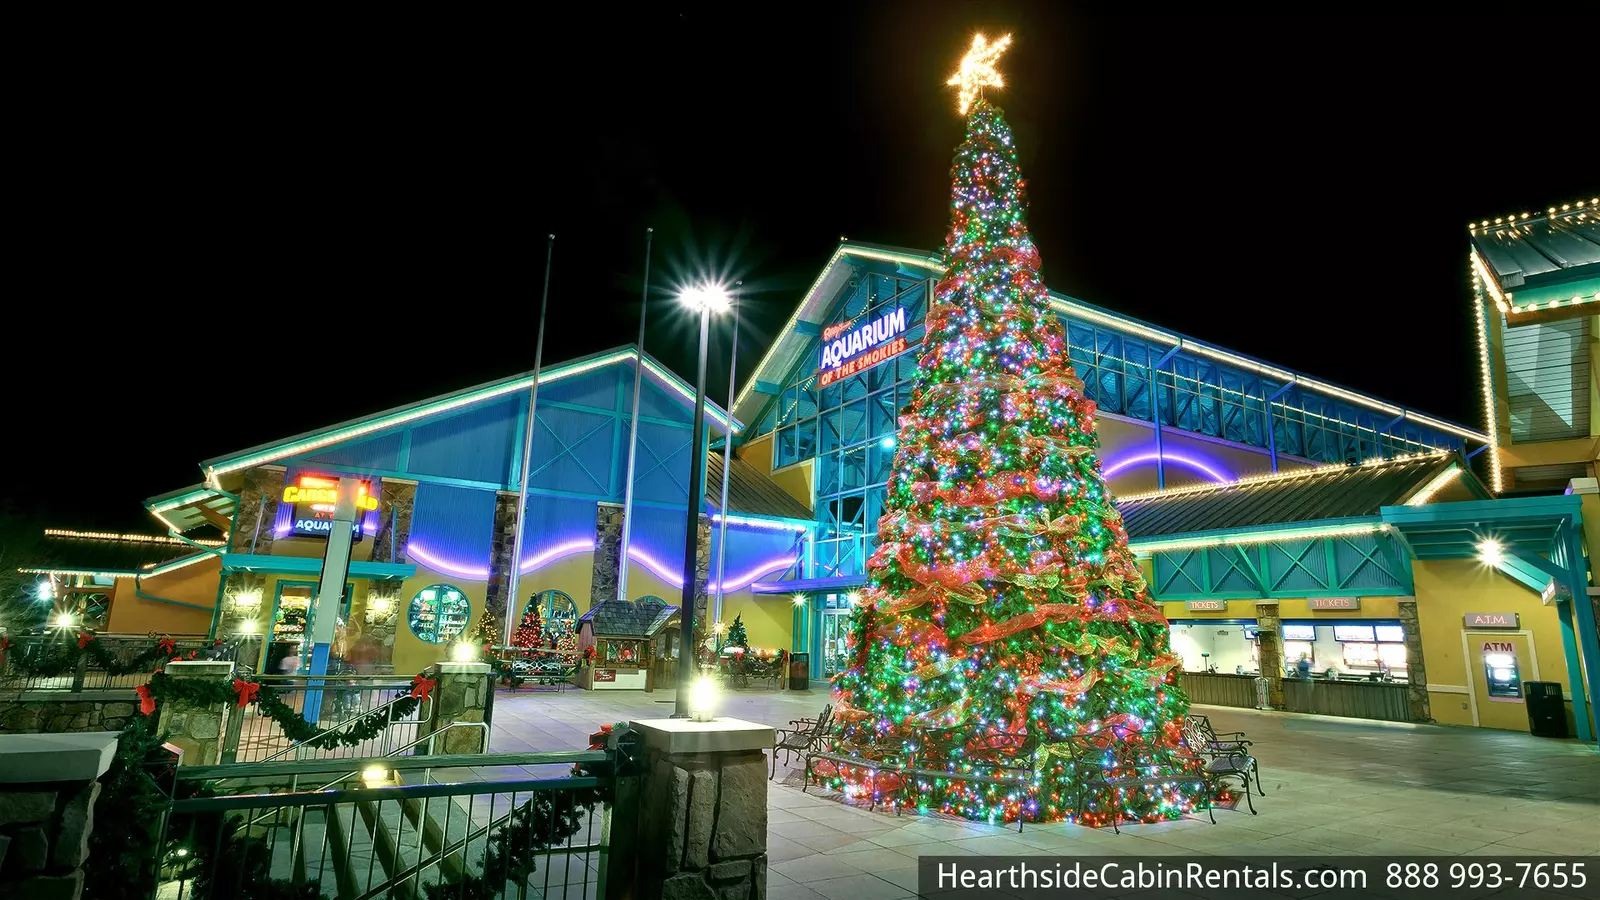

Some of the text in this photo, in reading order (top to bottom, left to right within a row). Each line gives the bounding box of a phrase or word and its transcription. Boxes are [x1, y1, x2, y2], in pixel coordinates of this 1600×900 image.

[821, 307, 905, 369] AQUARIUM
[821, 338, 905, 385] OF THE SMOKIES
[1315, 599, 1350, 607] TICKETS
[1475, 615, 1508, 624] A.T.M.
[1483, 642, 1513, 652] ATM
